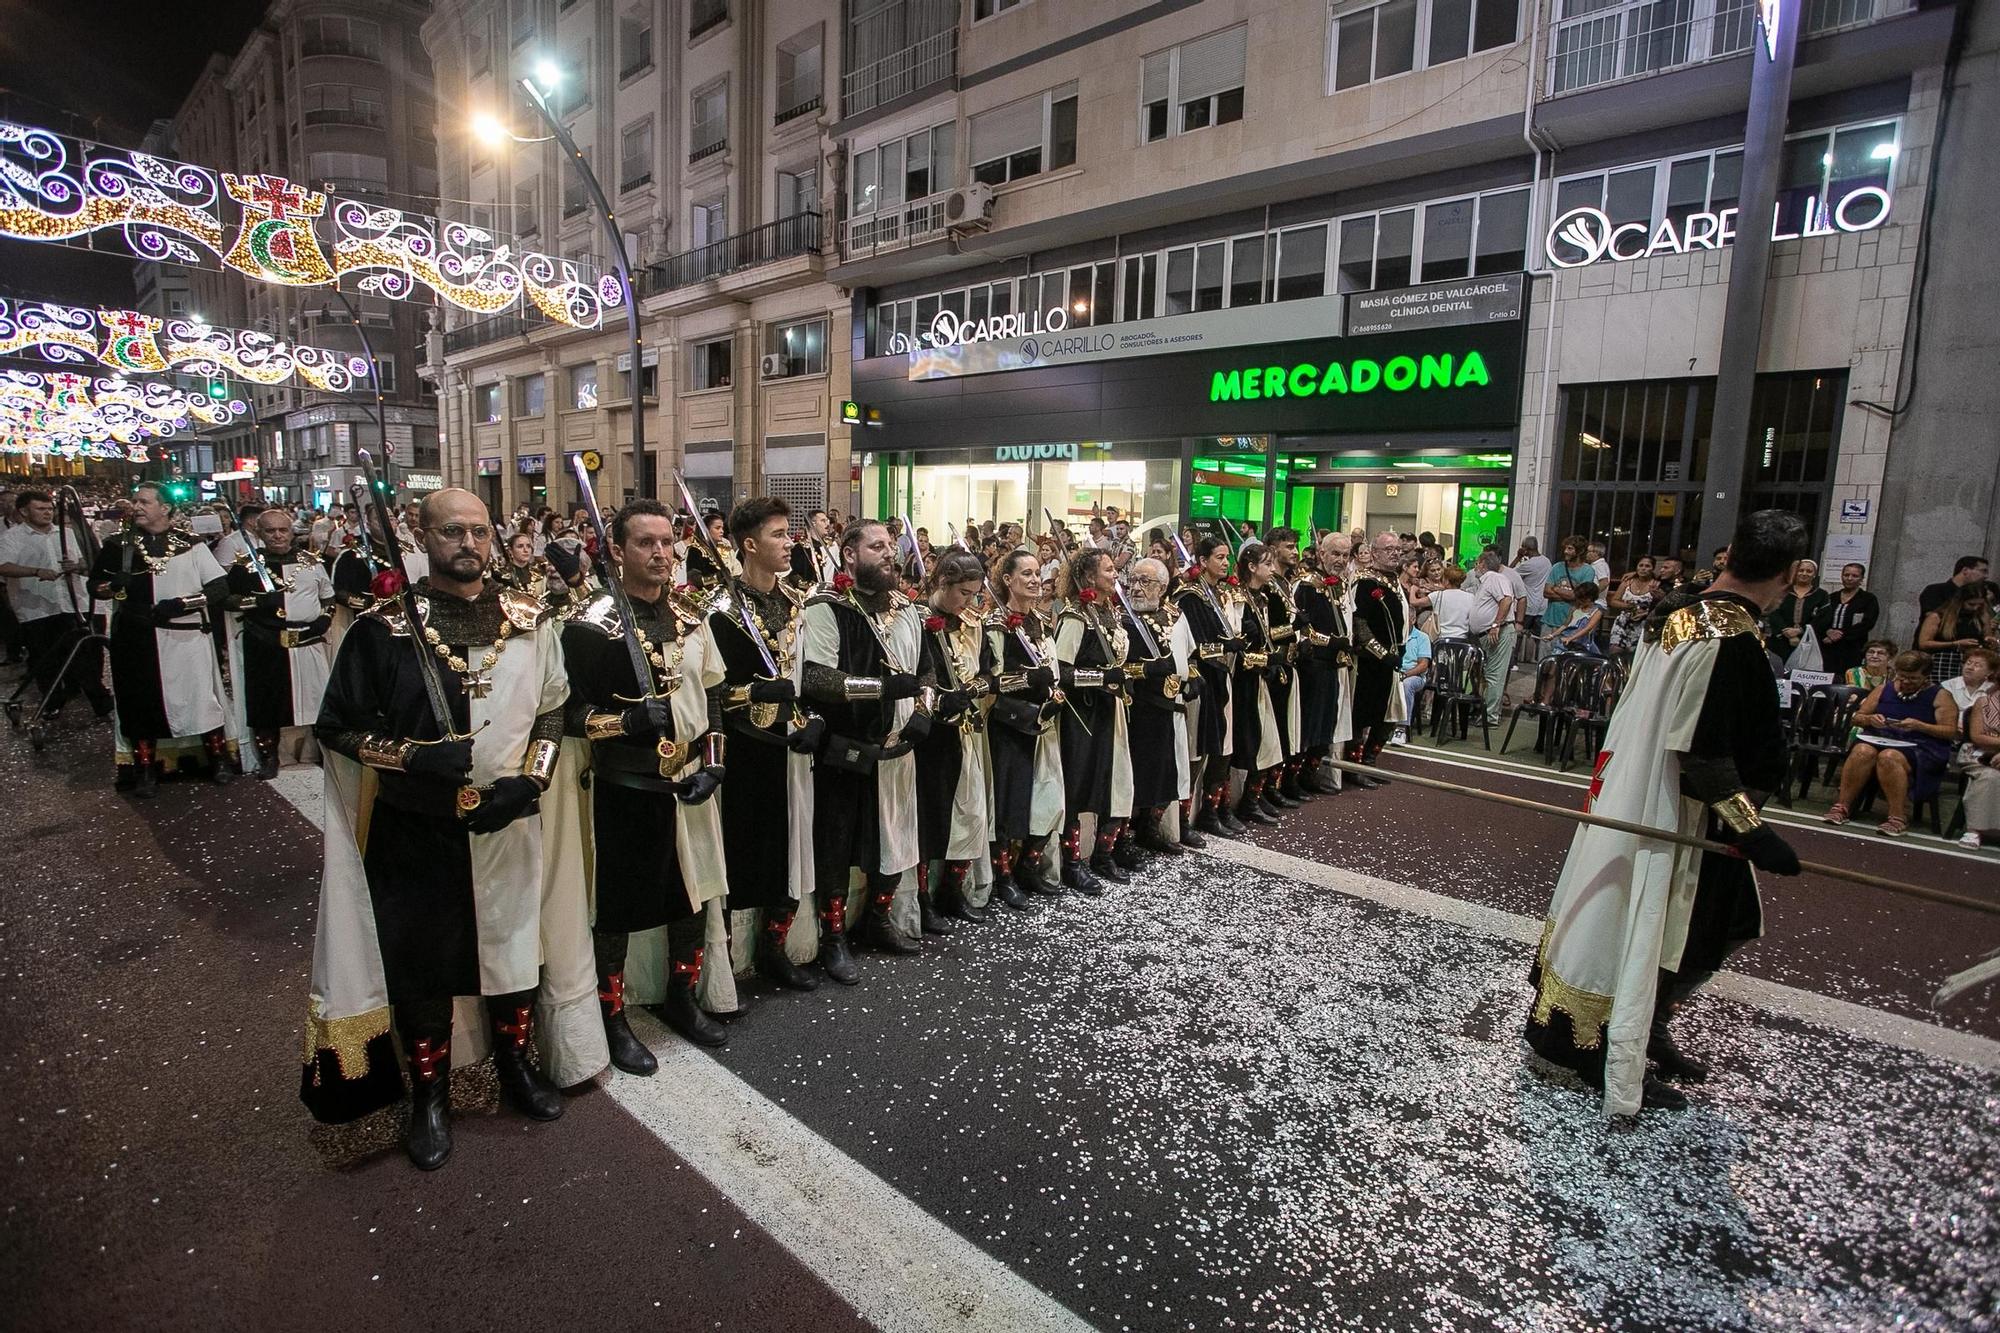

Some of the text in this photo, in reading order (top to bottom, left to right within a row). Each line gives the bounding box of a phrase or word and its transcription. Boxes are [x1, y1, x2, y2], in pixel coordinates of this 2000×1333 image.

[1608, 186, 1891, 261] CARRLLO
[1360, 283, 1509, 309] MASIÁ GÓMEZ DE VALCÁRCEL
[1390, 301, 1473, 318] CLÍNICA DENTAL
[958, 306, 1067, 344] CARRILLO
[1041, 333, 1115, 358] CARRILLO
[1120, 331, 1156, 342] ABOGADOS,
[1120, 339, 1163, 349] CONSULTORES
[1170, 334, 1203, 343] ASESORES
[1689, 358, 1697, 371] 7
[1210, 351, 1490, 401] MERCADONA
[1797, 673, 1828, 682] ASUNTOS
